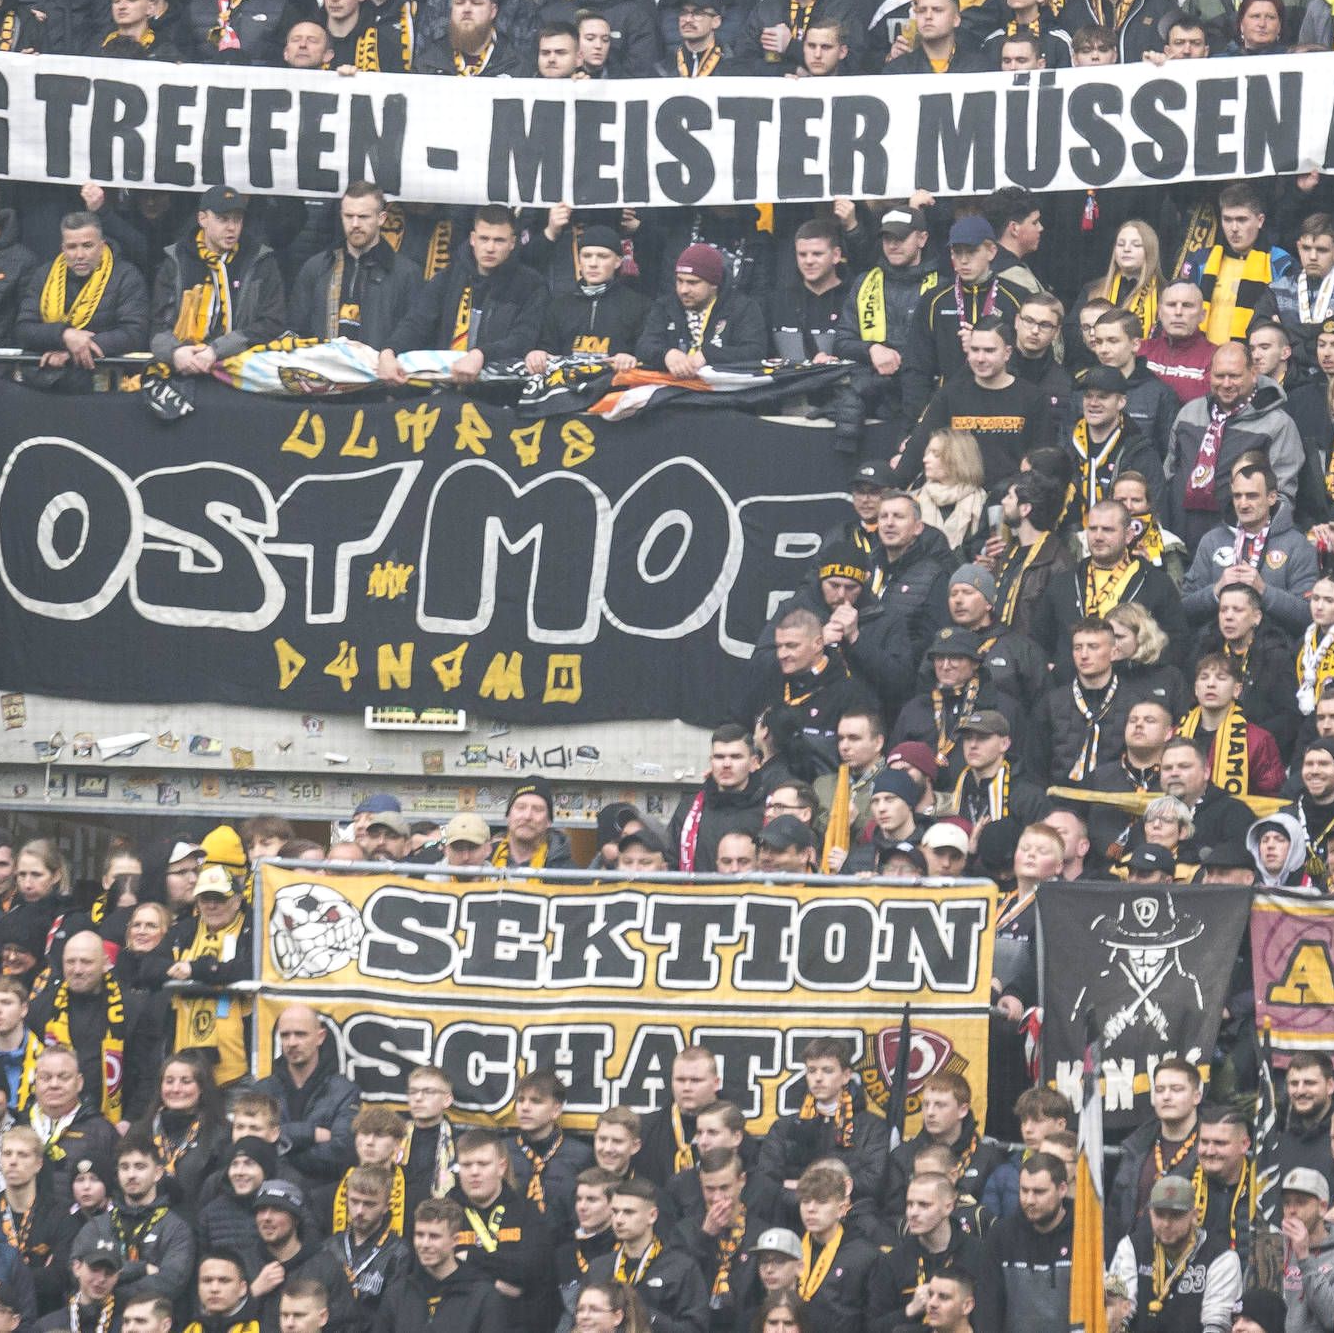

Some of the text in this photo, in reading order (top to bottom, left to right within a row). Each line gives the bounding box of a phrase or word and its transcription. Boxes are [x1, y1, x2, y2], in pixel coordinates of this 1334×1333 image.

[35, 73, 409, 196] TREFFEN
[425, 146, 459, 171] -
[486, 95, 890, 205] MEISTER
[915, 70, 1304, 192] MÜSSEN
[281, 402, 597, 468] ULTRAS
[274, 640, 584, 706] DYNAMO
[358, 885, 988, 993] SEKTION
[274, 1009, 868, 1123] SCHATZ
